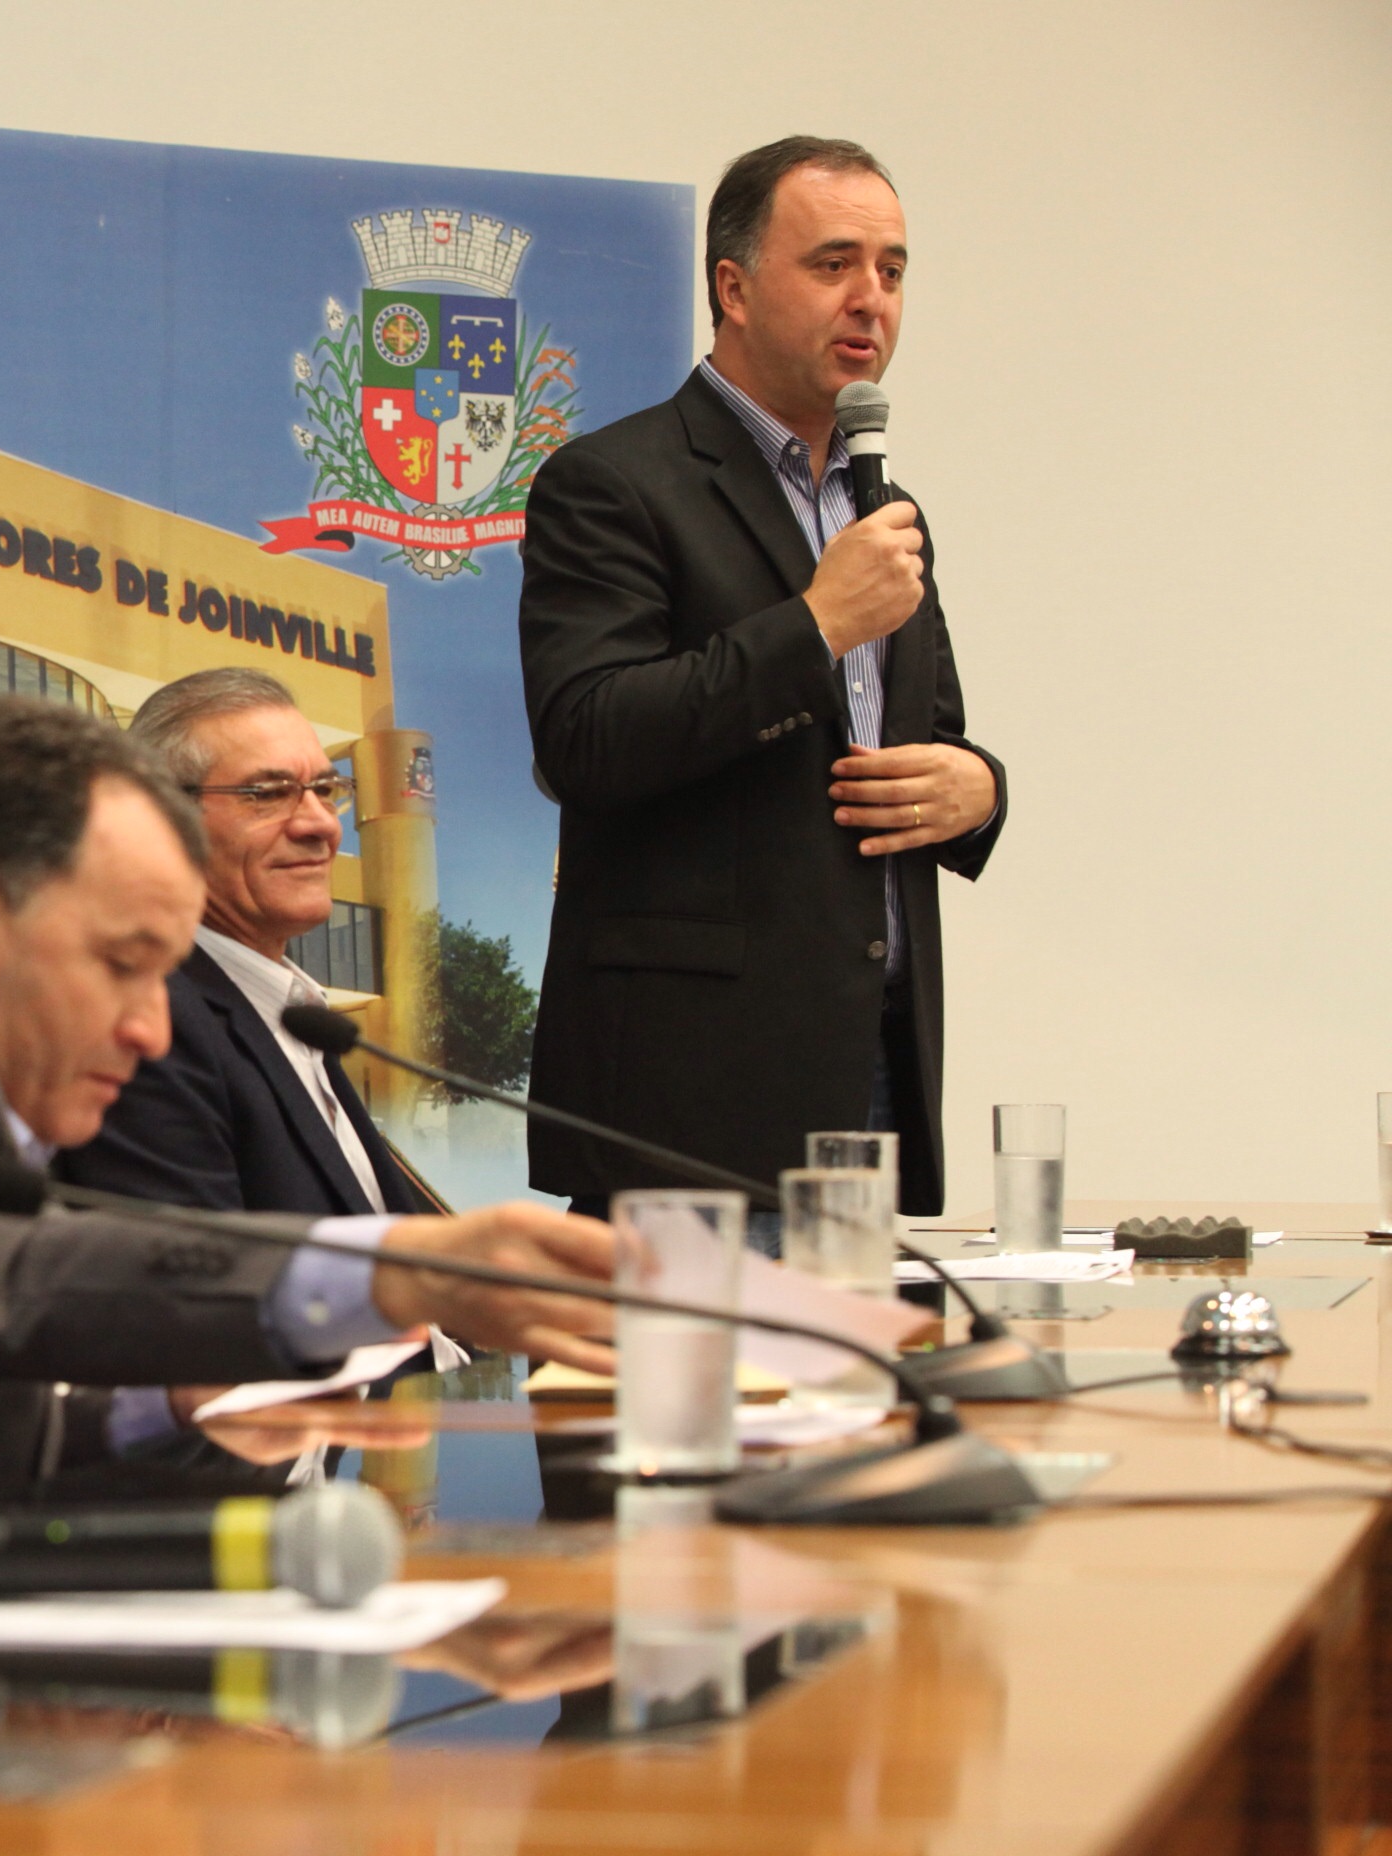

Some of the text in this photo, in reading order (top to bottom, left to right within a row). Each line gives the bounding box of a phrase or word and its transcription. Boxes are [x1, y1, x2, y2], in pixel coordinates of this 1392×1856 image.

[315, 508, 348, 527] MEA
[352, 511, 399, 536] AUTEM
[115, 558, 169, 617] DE
[178, 580, 376, 677] JOINVILLE
